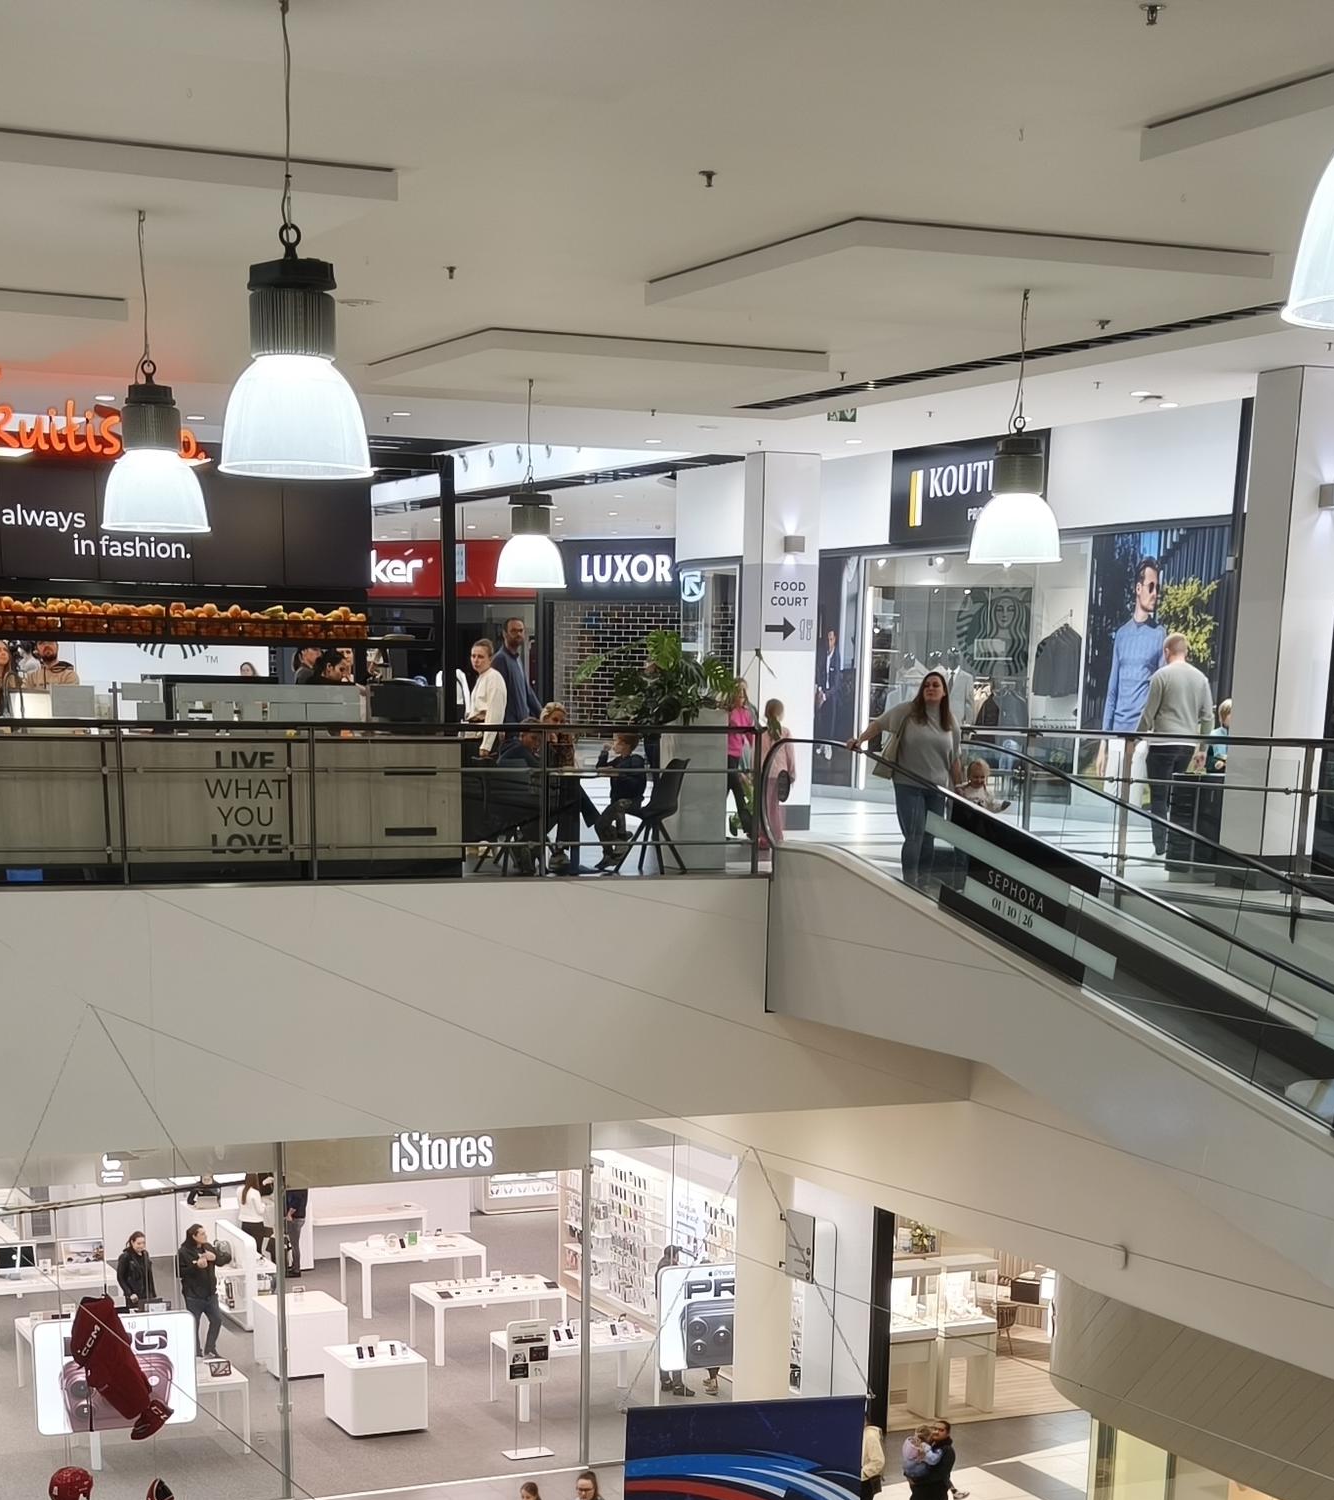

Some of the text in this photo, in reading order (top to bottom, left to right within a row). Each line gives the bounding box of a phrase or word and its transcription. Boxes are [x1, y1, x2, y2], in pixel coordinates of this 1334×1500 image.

[928, 459, 994, 498] KOUT
[2, 505, 87, 532] always
[73, 534, 192, 560] in fashion.
[581, 553, 673, 583] LUXOR
[773, 581, 806, 592] FOOD
[770, 597, 809, 607] COURT
[205, 655, 219, 664] TM
[215, 750, 275, 768] LIVE
[205, 778, 287, 799] WHAT
[216, 806, 273, 827] YOU
[211, 833, 283, 854] LOVE
[987, 870, 1044, 913] SEPHORA
[992, 897, 1001, 911] 01
[1007, 905, 1017, 919] 10
[1022, 914, 1033, 928] 26
[392, 1131, 493, 1173] iStores
[685, 1278, 734, 1299] PR
[80, 1324, 101, 1357] CCM
